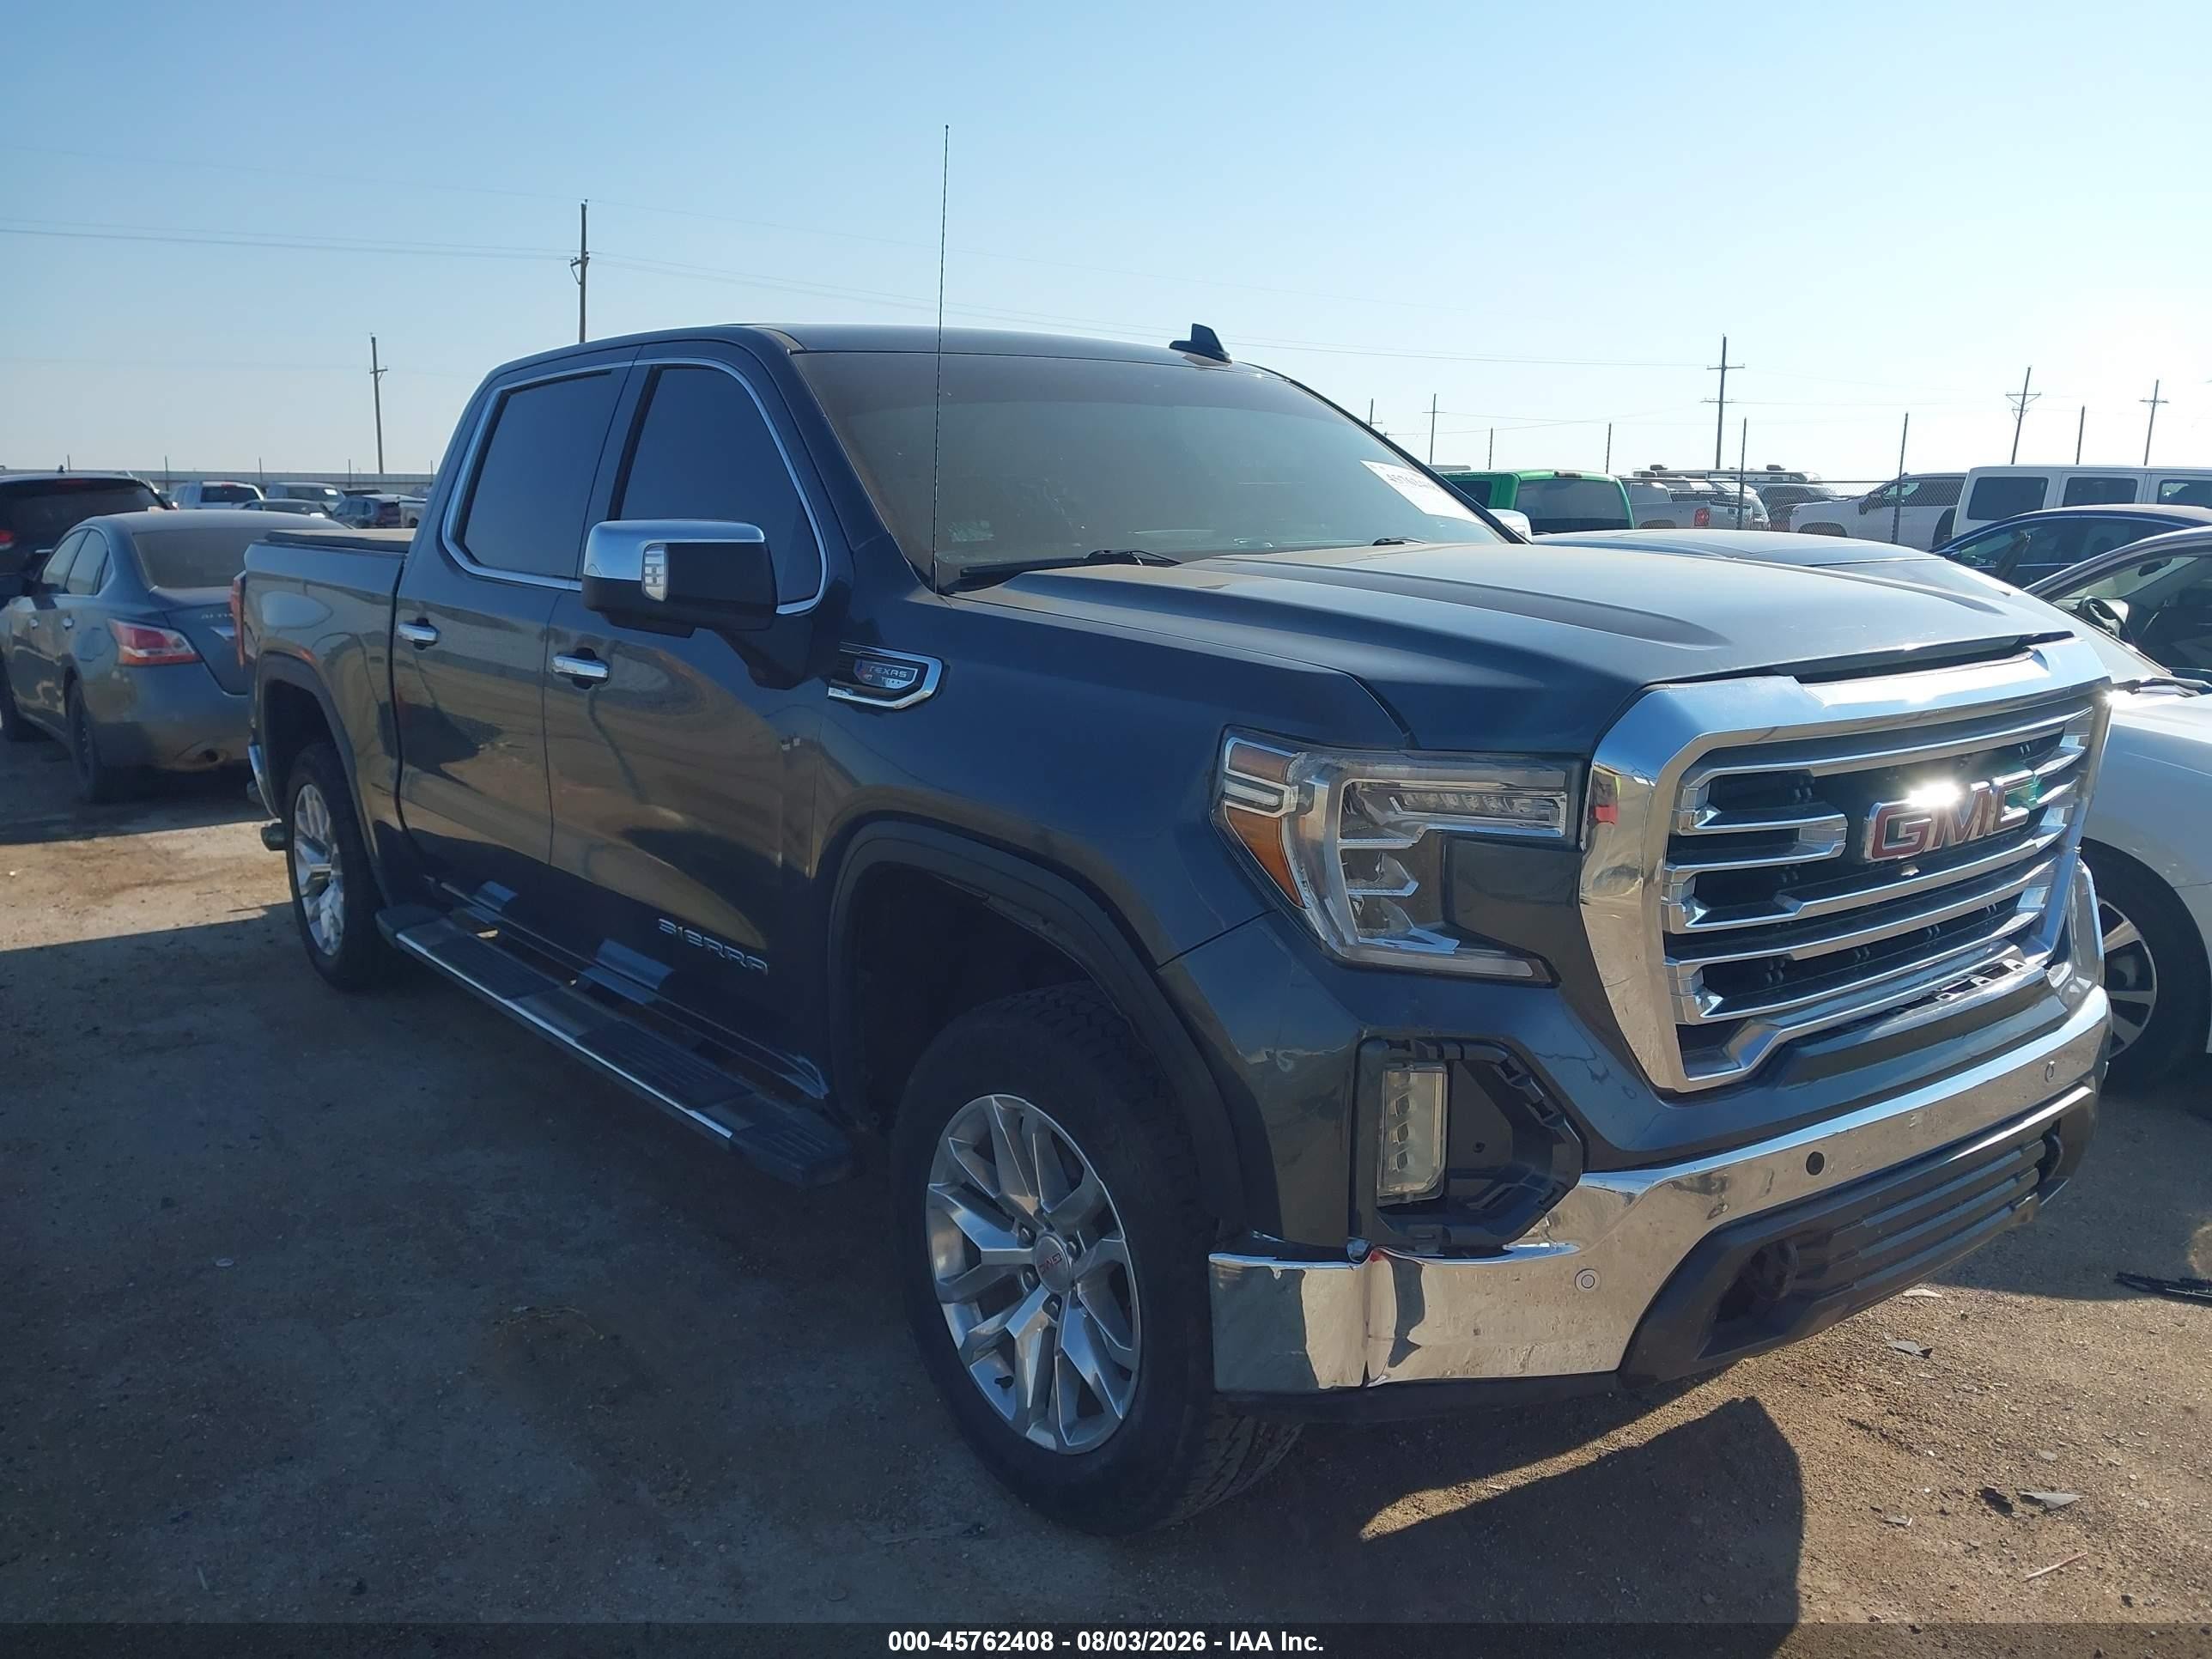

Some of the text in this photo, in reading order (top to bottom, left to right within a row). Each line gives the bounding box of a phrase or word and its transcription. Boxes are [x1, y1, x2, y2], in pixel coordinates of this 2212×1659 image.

[868, 665, 908, 678] TEXAS
[1863, 769, 2035, 862] GMC
[659, 918, 769, 976] SIERRA
